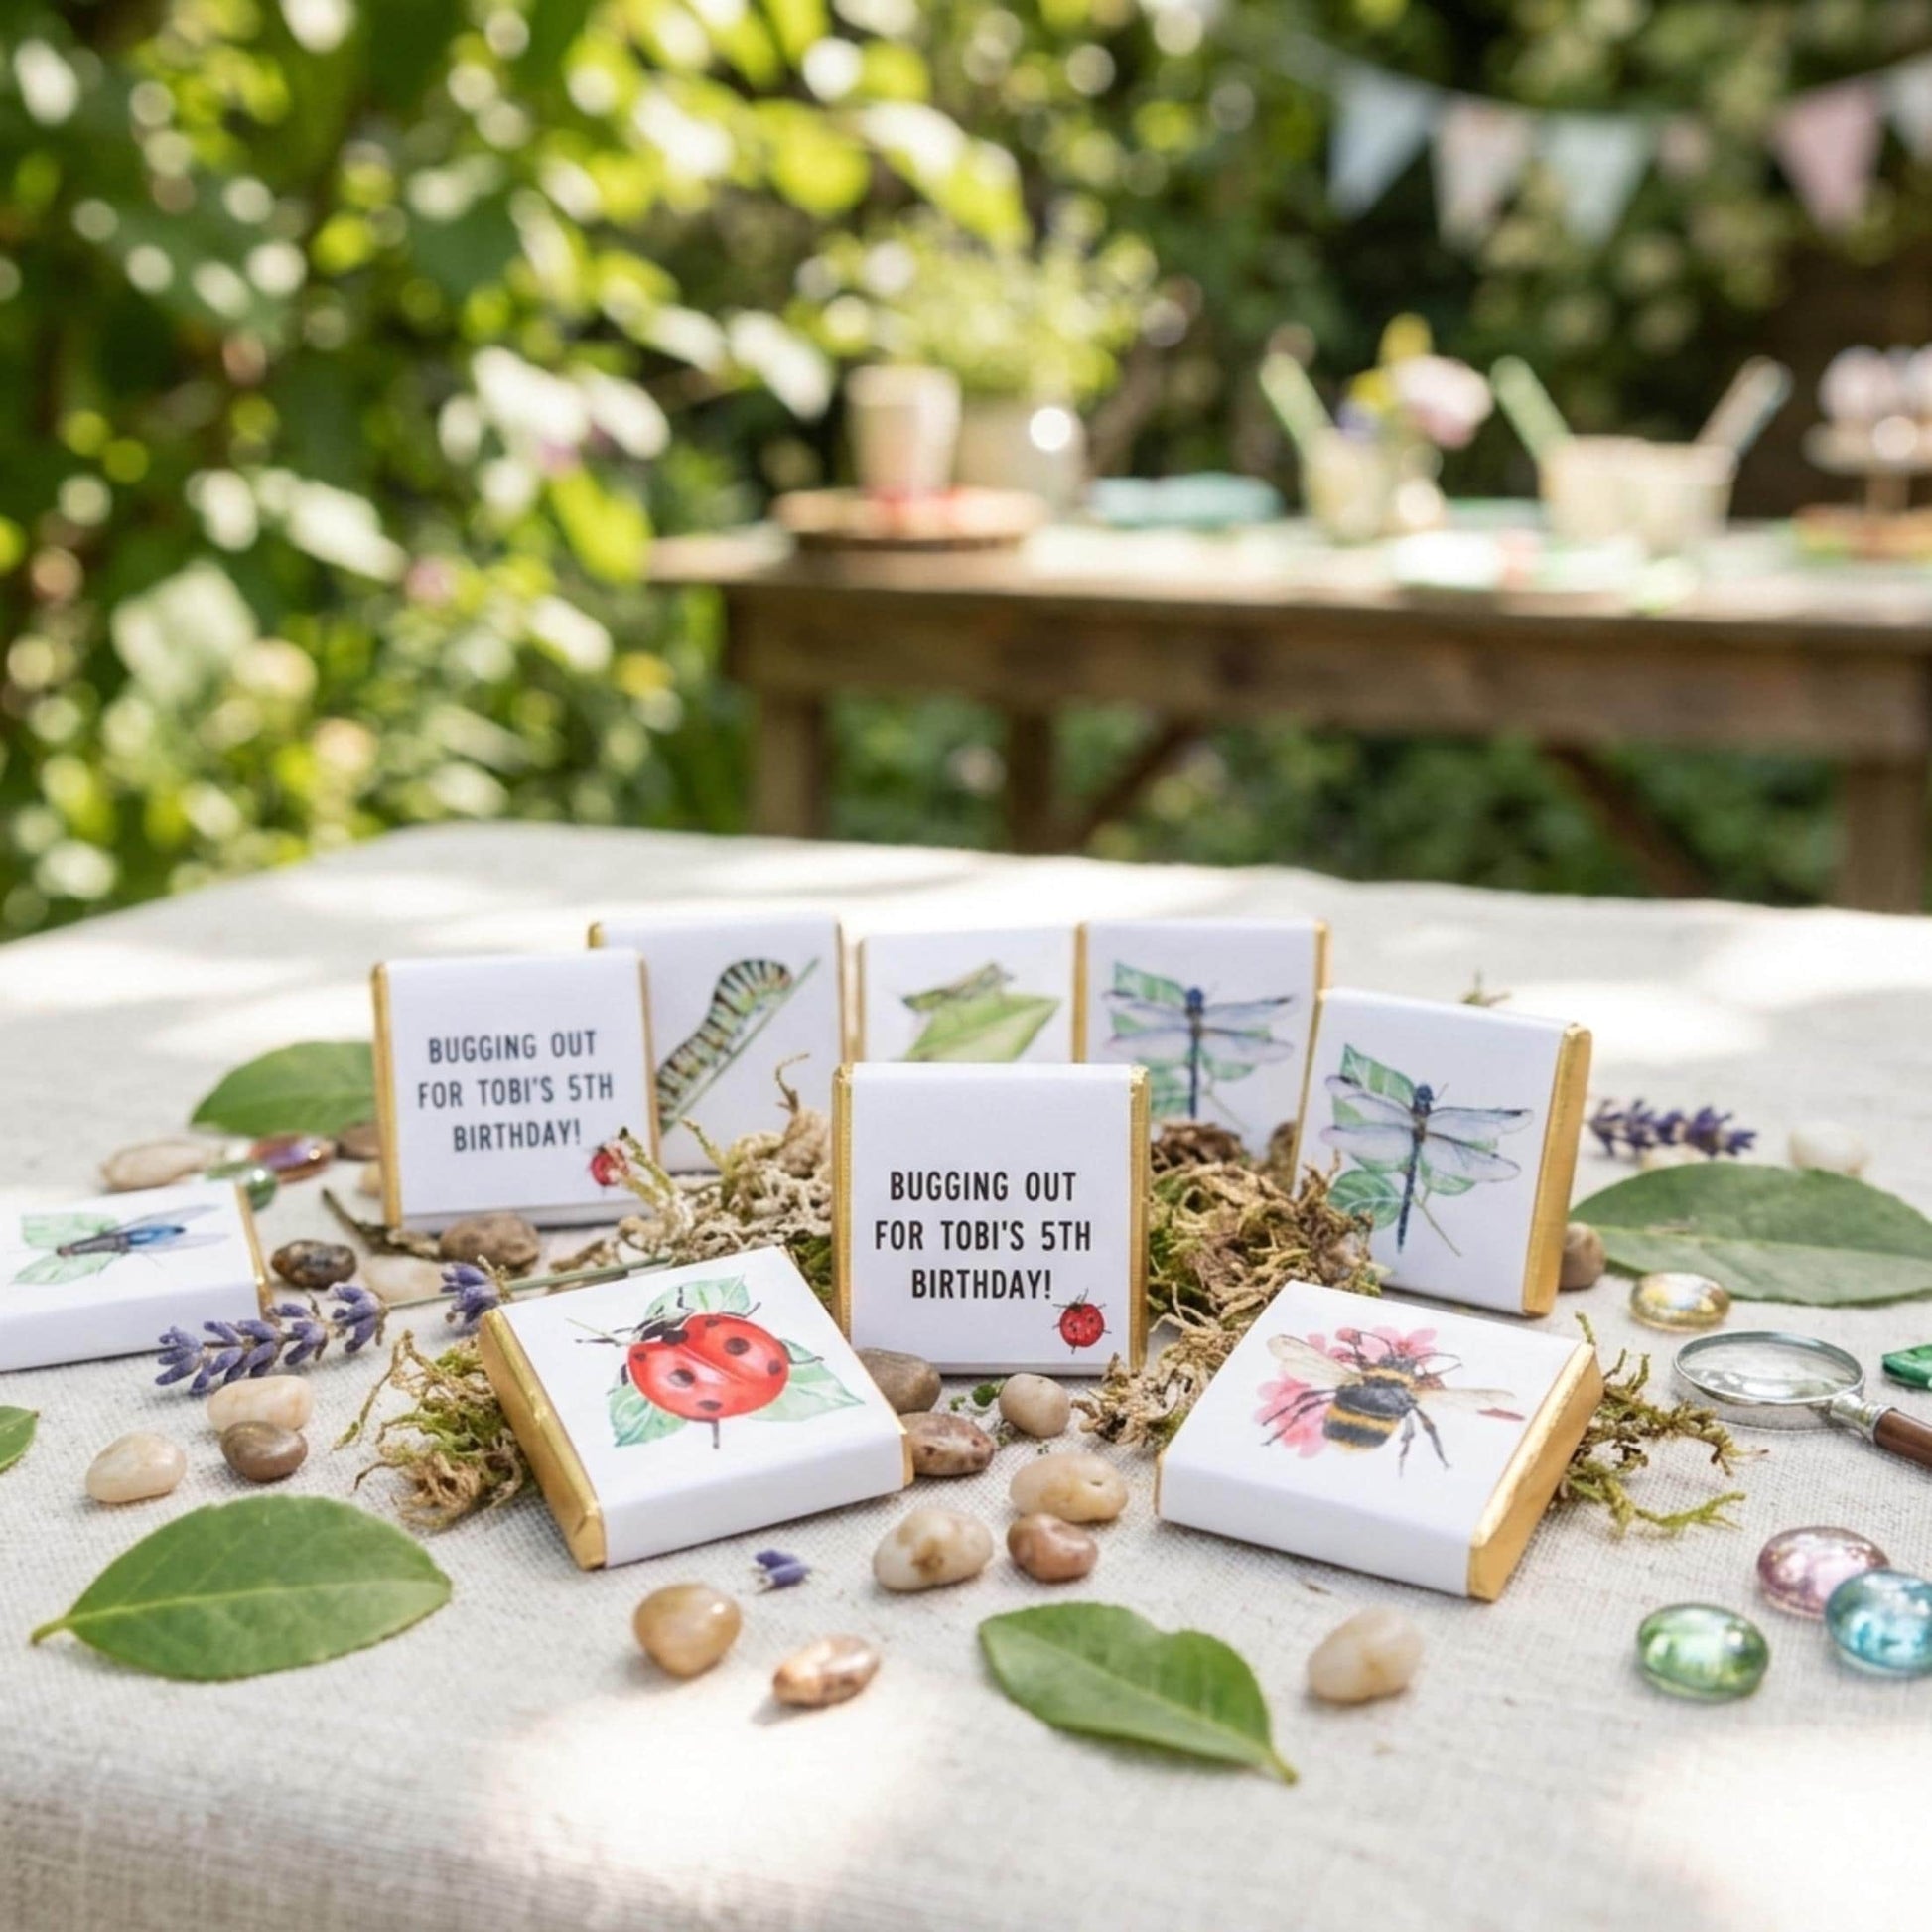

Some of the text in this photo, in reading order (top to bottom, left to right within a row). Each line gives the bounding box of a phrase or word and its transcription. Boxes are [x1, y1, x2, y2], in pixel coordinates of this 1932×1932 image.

[429, 1031, 597, 1064] BUGGING OUT
[418, 1073, 614, 1109] FOR TOBI'S 5TH
[453, 1119, 581, 1152] BIRTHDAY!
[890, 1171, 1077, 1202] BUGGING OUT
[875, 1220, 1091, 1252] FOR TOBI'S 5TH
[911, 1269, 1052, 1300] BIRTHDAY!
